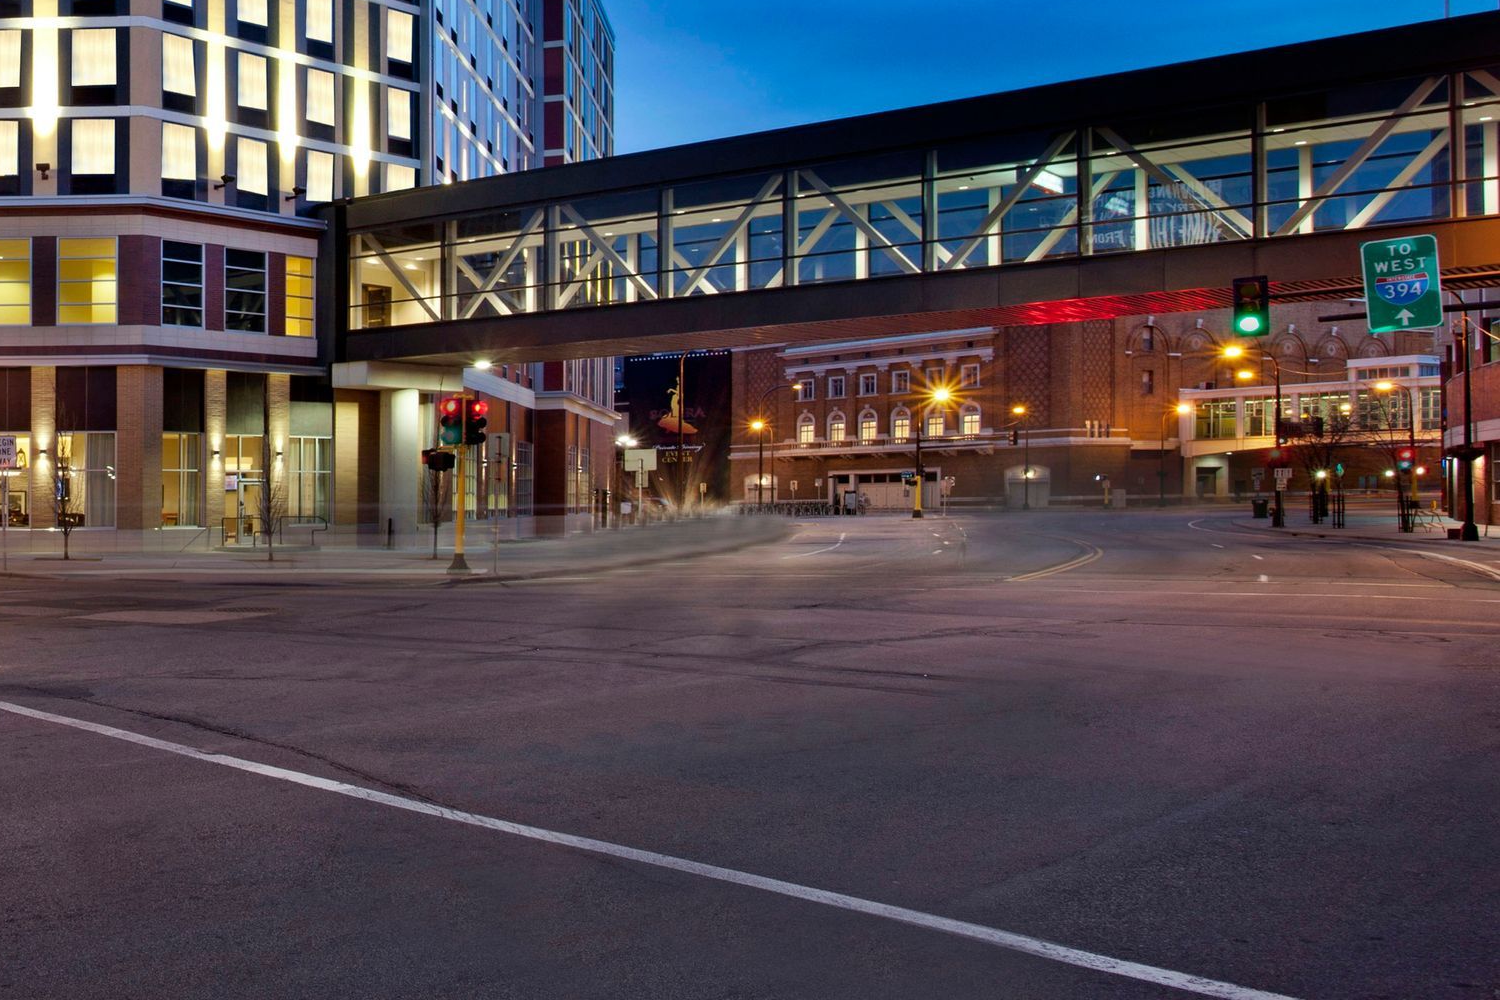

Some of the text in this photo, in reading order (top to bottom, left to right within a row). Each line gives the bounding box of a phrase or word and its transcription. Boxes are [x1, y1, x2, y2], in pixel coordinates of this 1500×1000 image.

[1387, 243, 1411, 257] TO
[1374, 256, 1426, 273] WEST
[1384, 281, 1422, 299] 394
